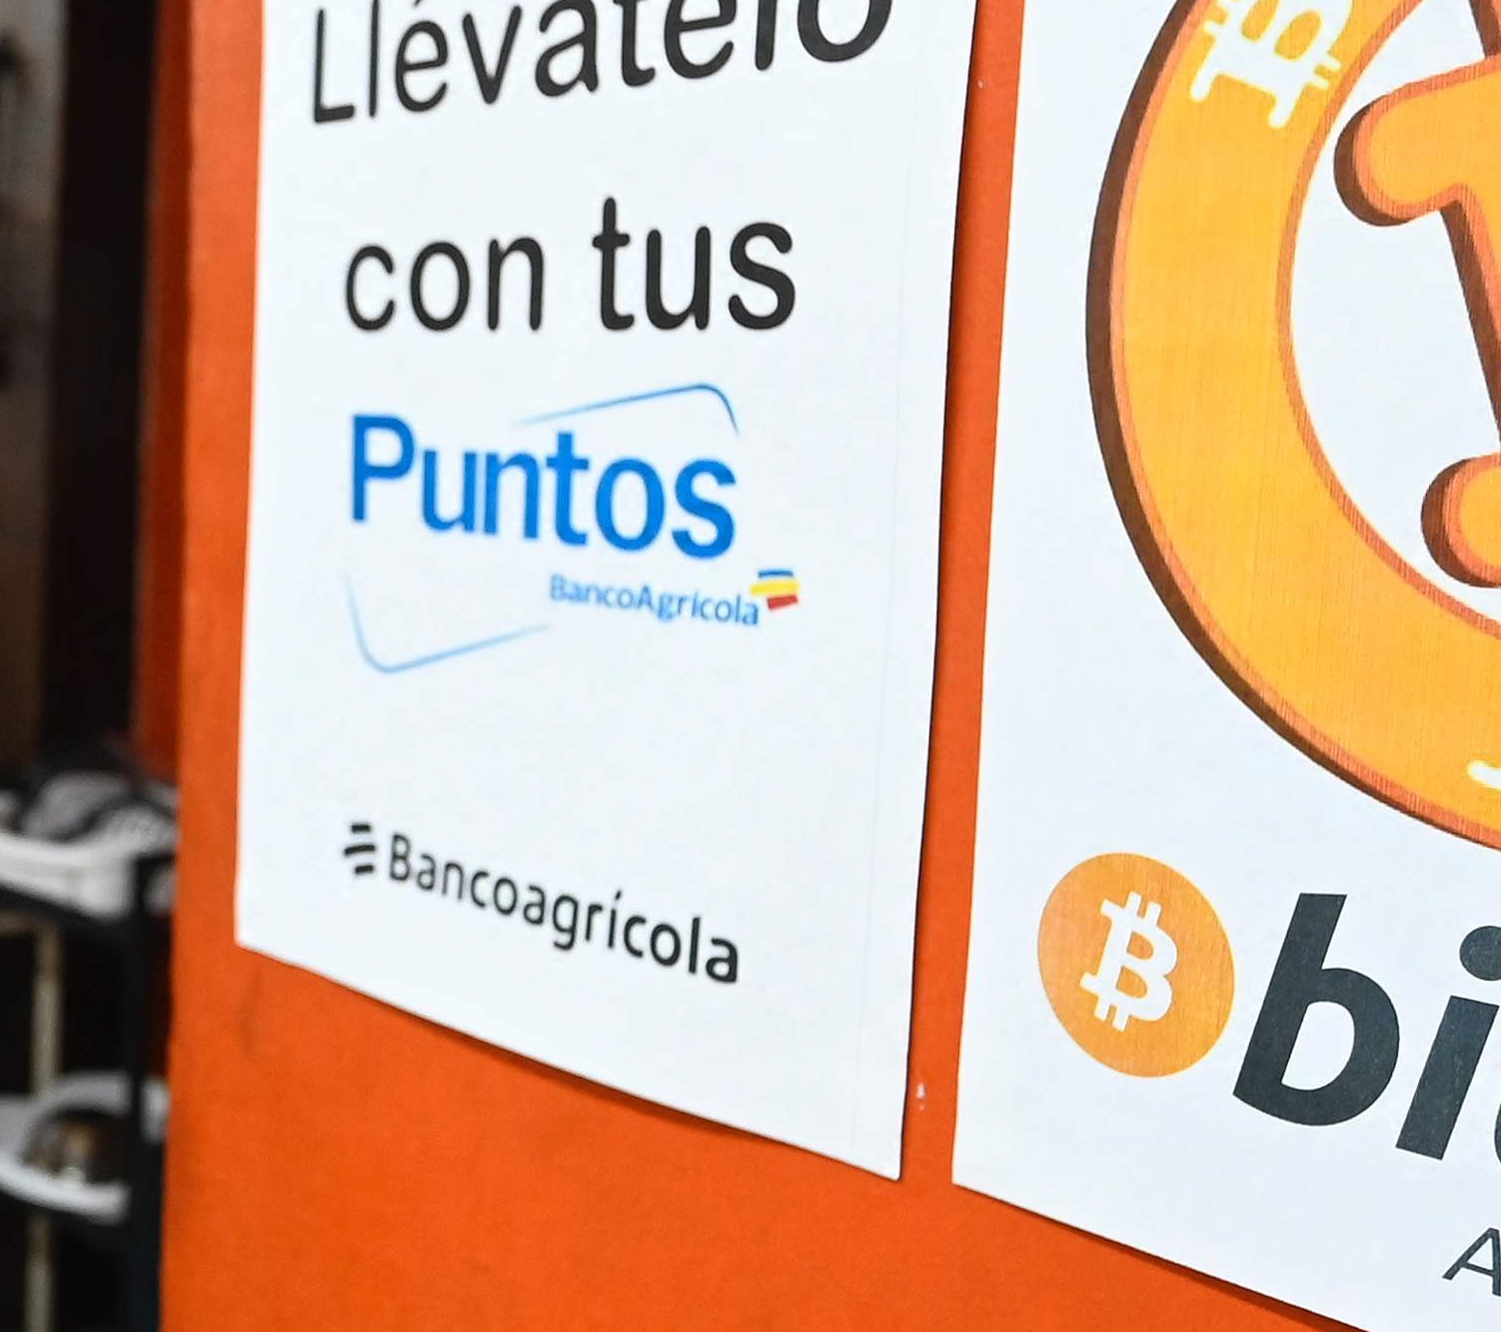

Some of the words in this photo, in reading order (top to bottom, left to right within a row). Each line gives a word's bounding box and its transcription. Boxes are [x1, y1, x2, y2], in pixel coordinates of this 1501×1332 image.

[344, 235, 546, 332] con
[591, 196, 797, 332] tus
[350, 412, 739, 562] Puntos
[549, 573, 760, 627] BancoAgrícola
[388, 831, 740, 986] Bancoagrícola
